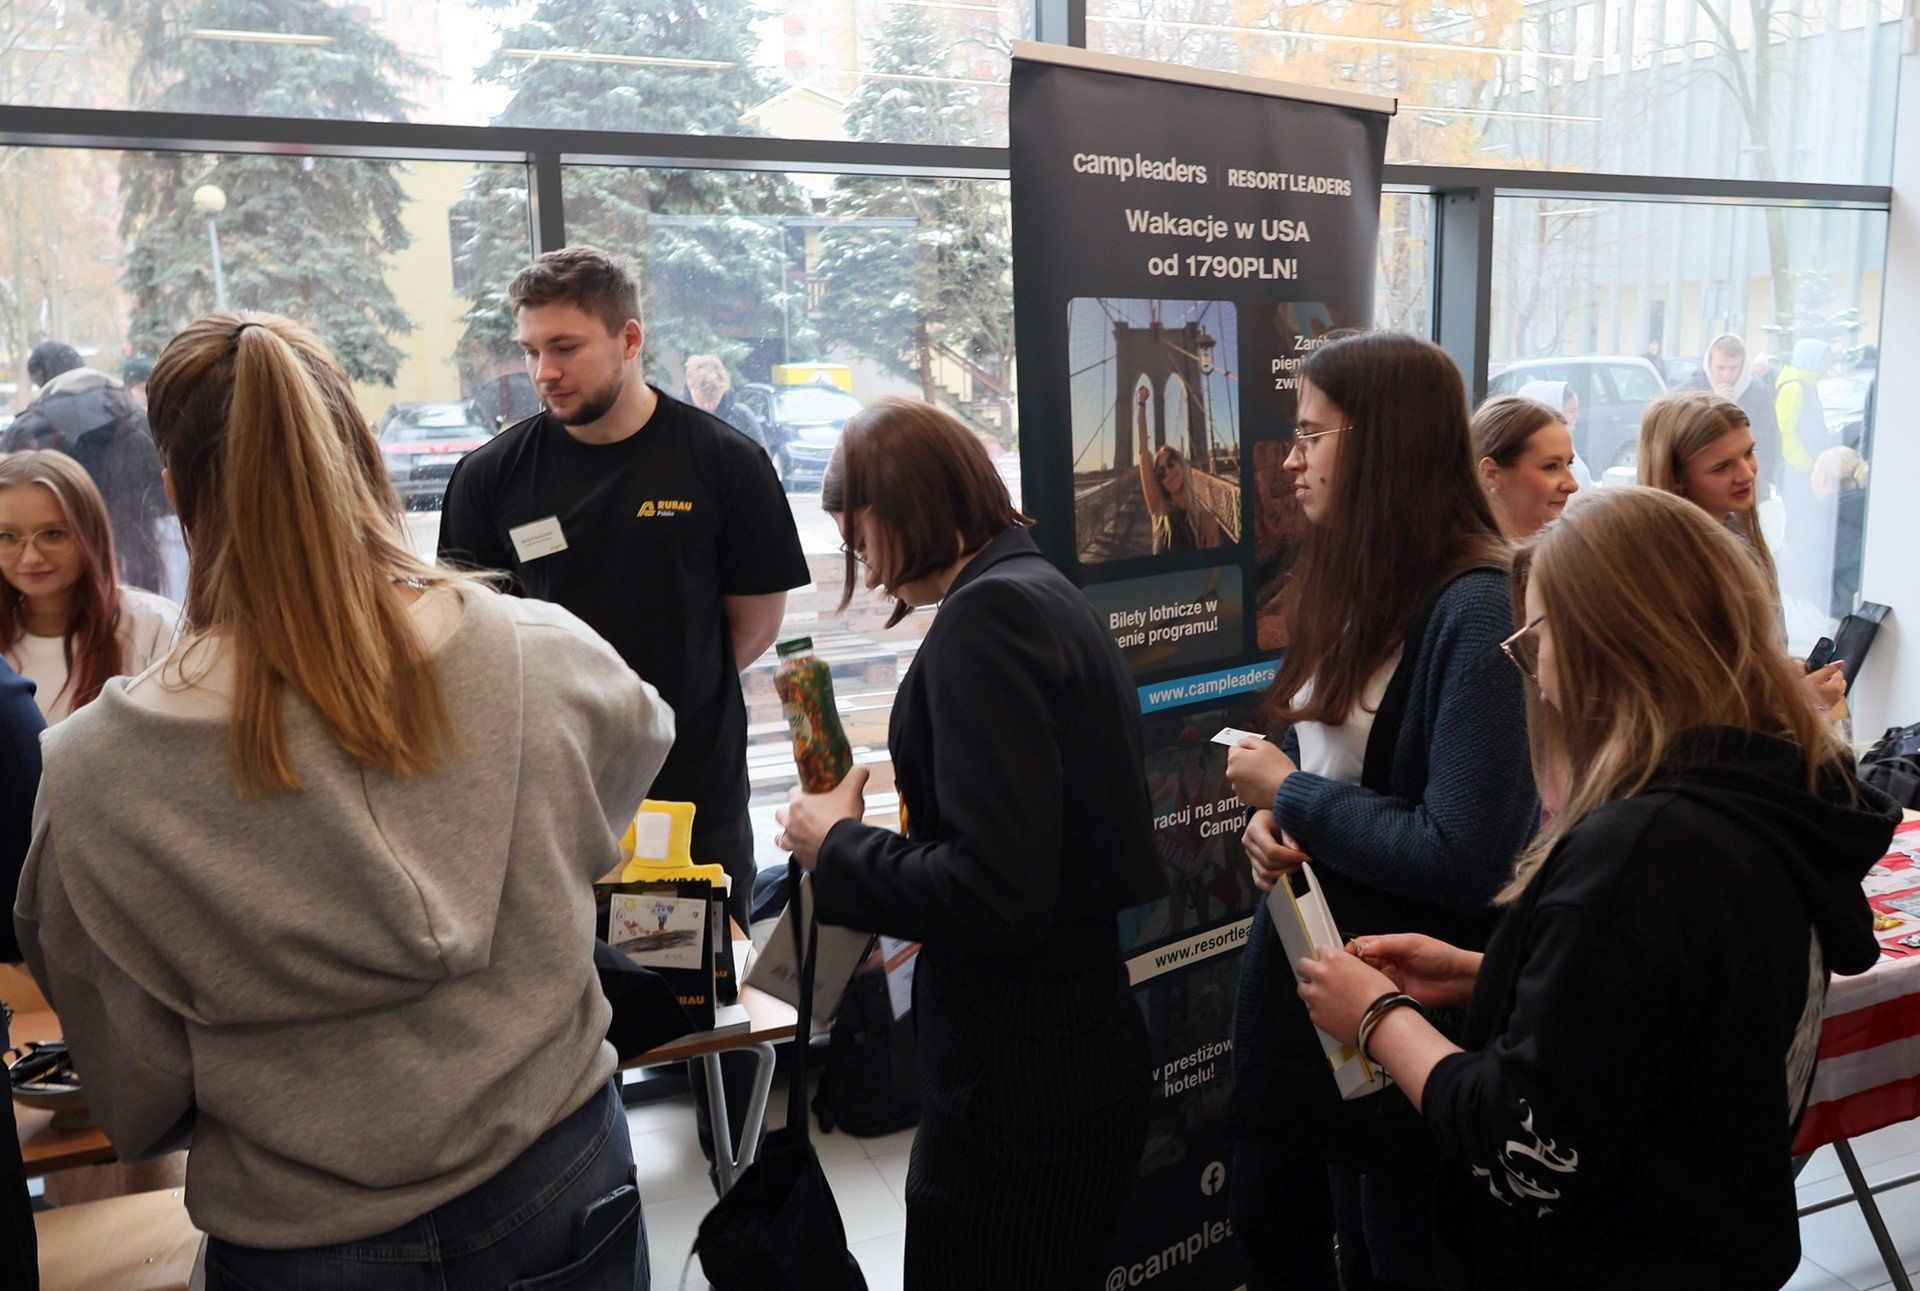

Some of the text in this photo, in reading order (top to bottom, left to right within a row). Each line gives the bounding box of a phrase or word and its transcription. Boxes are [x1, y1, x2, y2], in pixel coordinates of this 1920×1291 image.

[1125, 208, 1311, 243] Wakacje w USA
[1147, 253, 1299, 280] od 1790PLN!
[1274, 375, 1299, 390] zwi
[657, 499, 693, 511] RUBAU
[1109, 600, 1218, 630] Bilety lotnicze w
[1114, 616, 1218, 649] enie programu!
[1153, 804, 1191, 831] racuj
[1195, 803, 1213, 819] na
[1199, 810, 1247, 839] Campi
[1164, 1062, 1216, 1098] hotelu!
